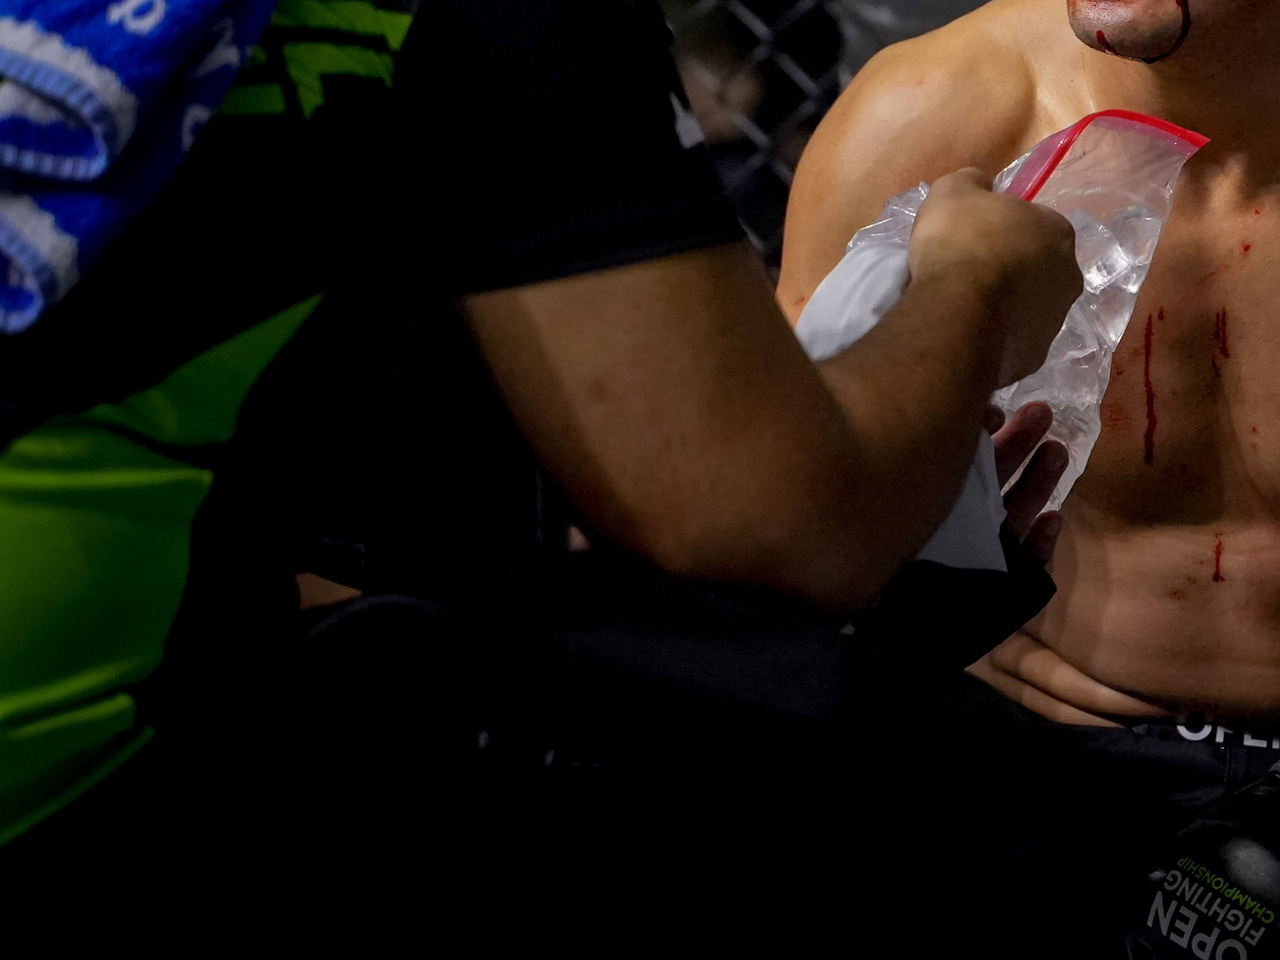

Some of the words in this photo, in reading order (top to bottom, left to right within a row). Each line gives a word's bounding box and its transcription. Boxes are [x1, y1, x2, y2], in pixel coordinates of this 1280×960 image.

[1146, 890, 1249, 960] OPEN
[1162, 869, 1266, 947] FIGHTING
[1176, 856, 1275, 925] CHAMPIONSHIP
